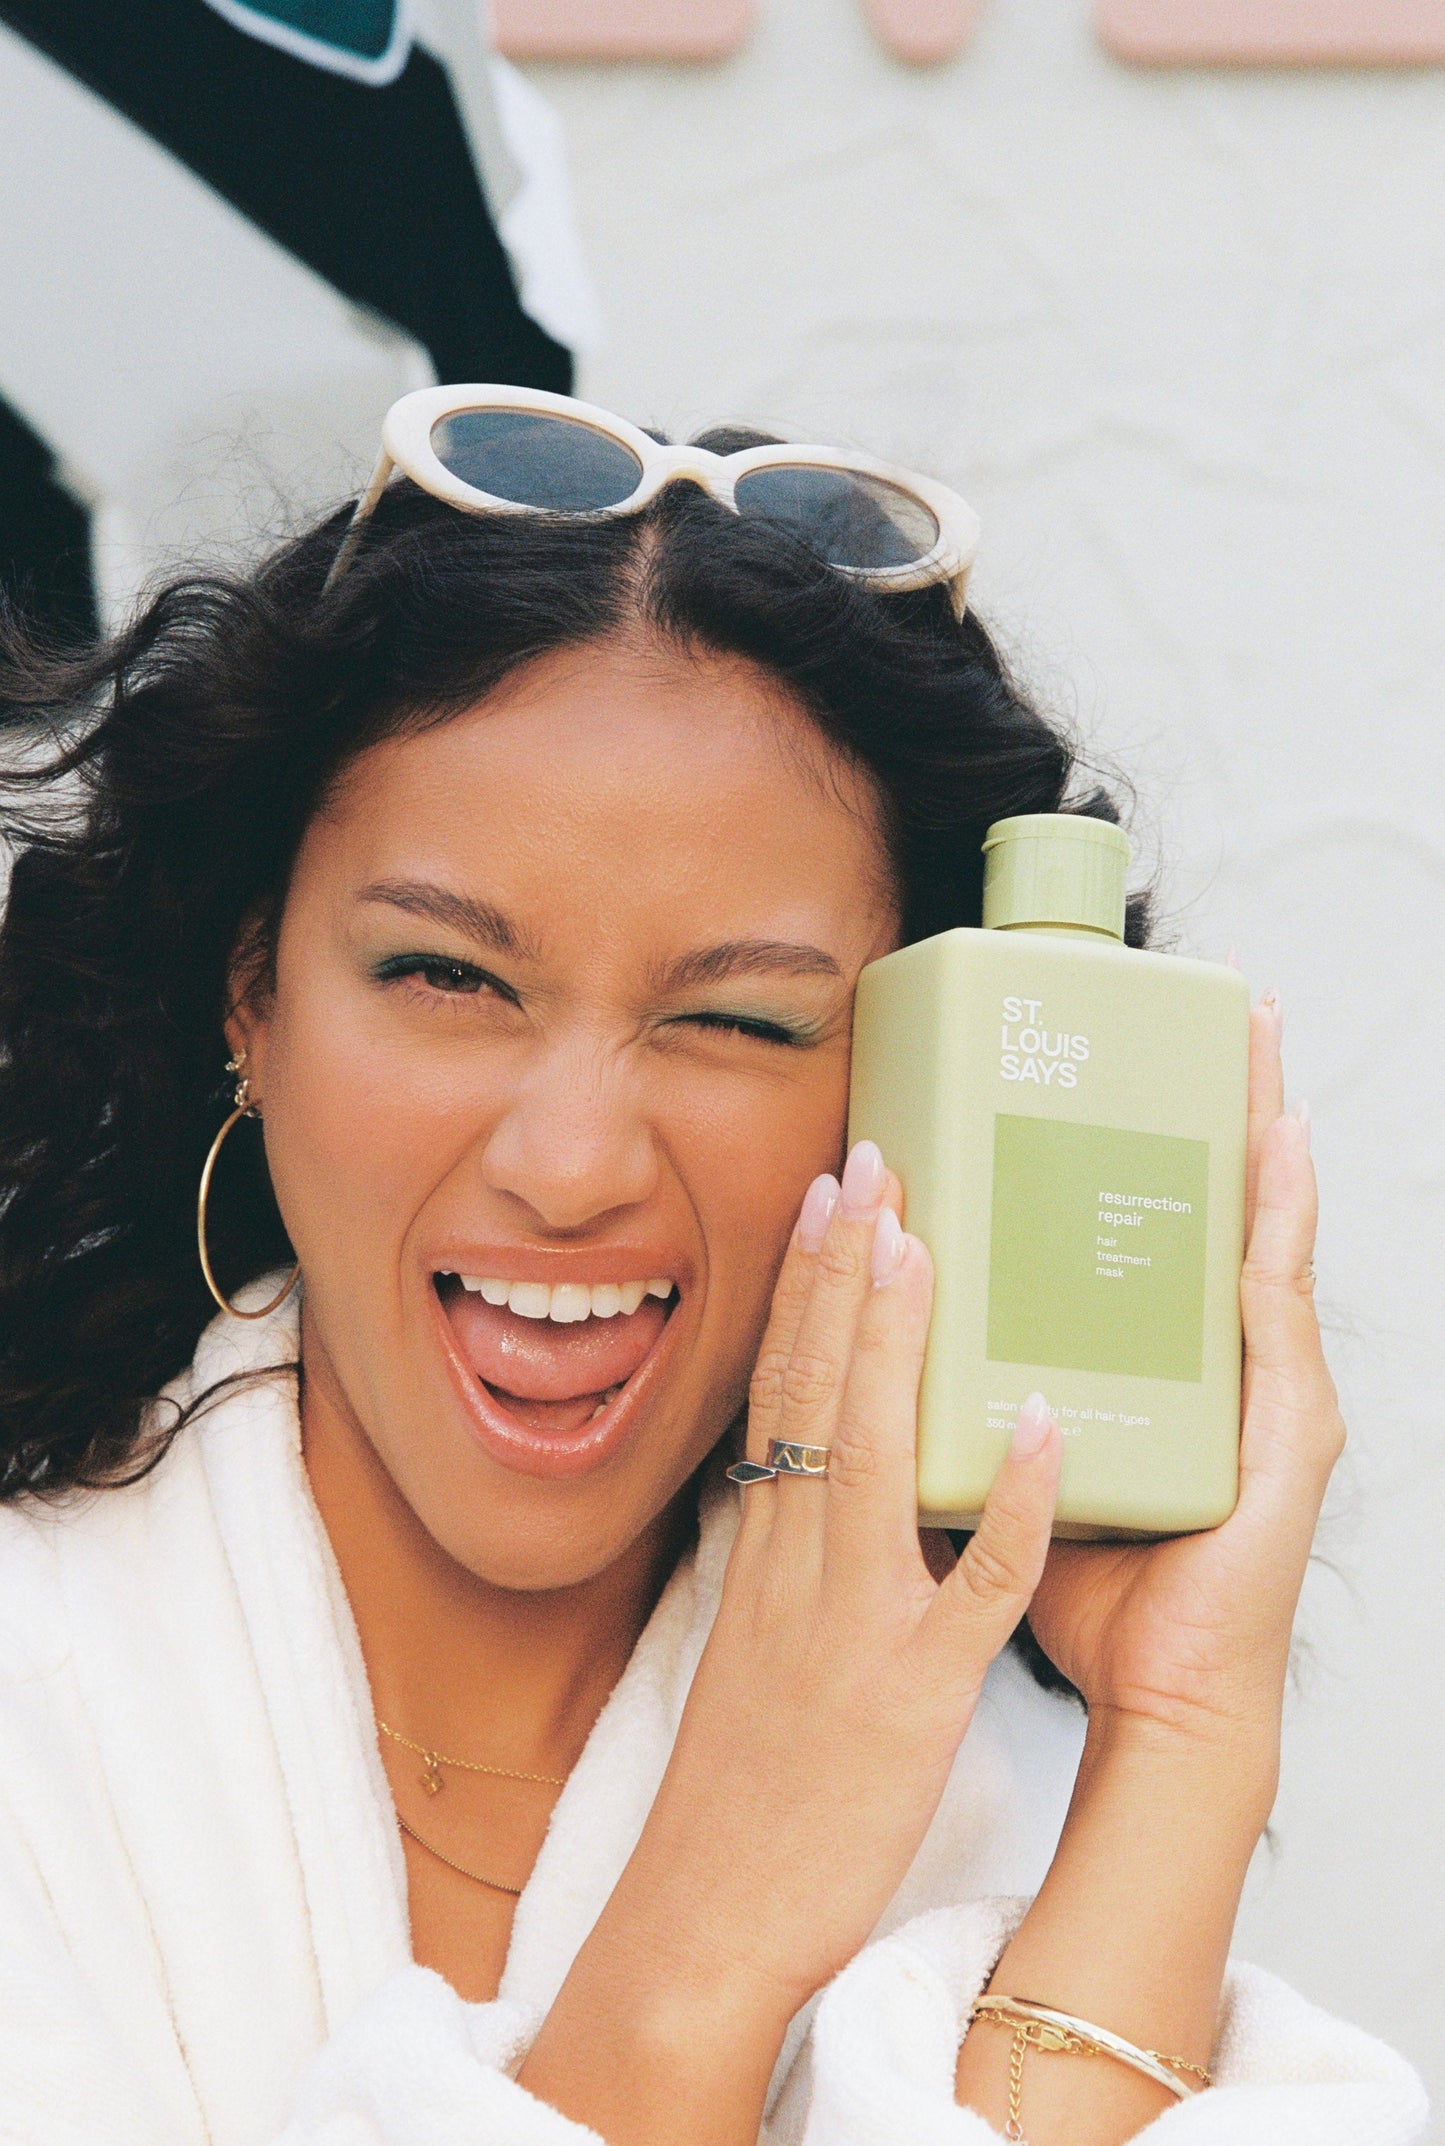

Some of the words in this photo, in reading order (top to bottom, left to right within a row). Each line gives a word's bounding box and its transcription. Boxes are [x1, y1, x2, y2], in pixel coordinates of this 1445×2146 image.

[1002, 996, 1043, 1025] ST.
[1001, 1025, 1090, 1061] LOUIS
[1000, 1054, 1078, 1089] SAYS
[1098, 1191, 1192, 1214] resurrection
[1098, 1211, 1143, 1227] repair
[1097, 1235, 1118, 1247] hair
[1096, 1251, 1152, 1267] treatment
[1096, 1267, 1124, 1278] mask
[986, 1417, 1005, 1429] 350
[987, 1400, 1018, 1411] salon
[1062, 1406, 1079, 1418] for
[1080, 1408, 1093, 1420] all
[1095, 1410, 1117, 1422] hair
[1119, 1412, 1151, 1427] types
